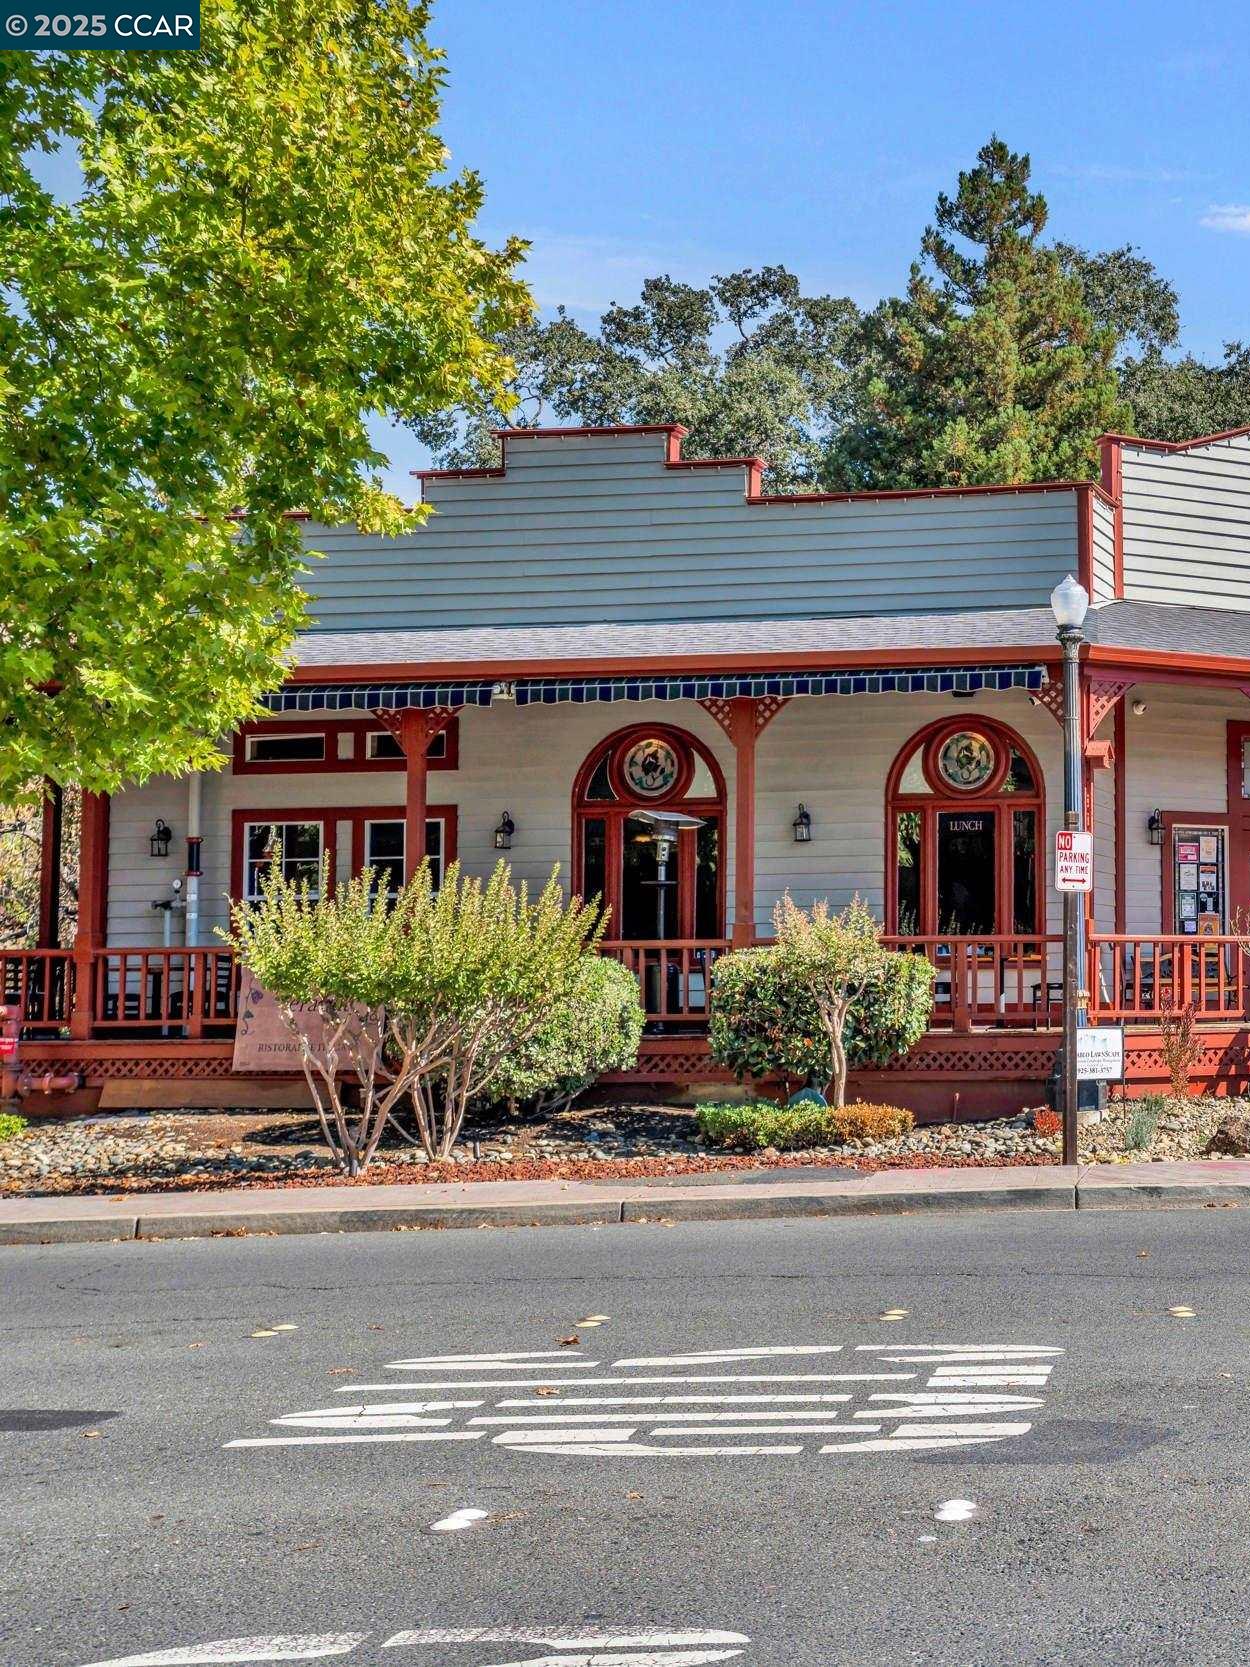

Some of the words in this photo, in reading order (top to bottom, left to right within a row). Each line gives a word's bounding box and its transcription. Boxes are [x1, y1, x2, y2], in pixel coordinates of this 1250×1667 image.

[950, 820, 984, 831] LUNCH
[1058, 834, 1072, 849] NO
[1059, 851, 1090, 863] PARKING
[1060, 865, 1073, 874] ANY
[1075, 865, 1089, 875] TIME
